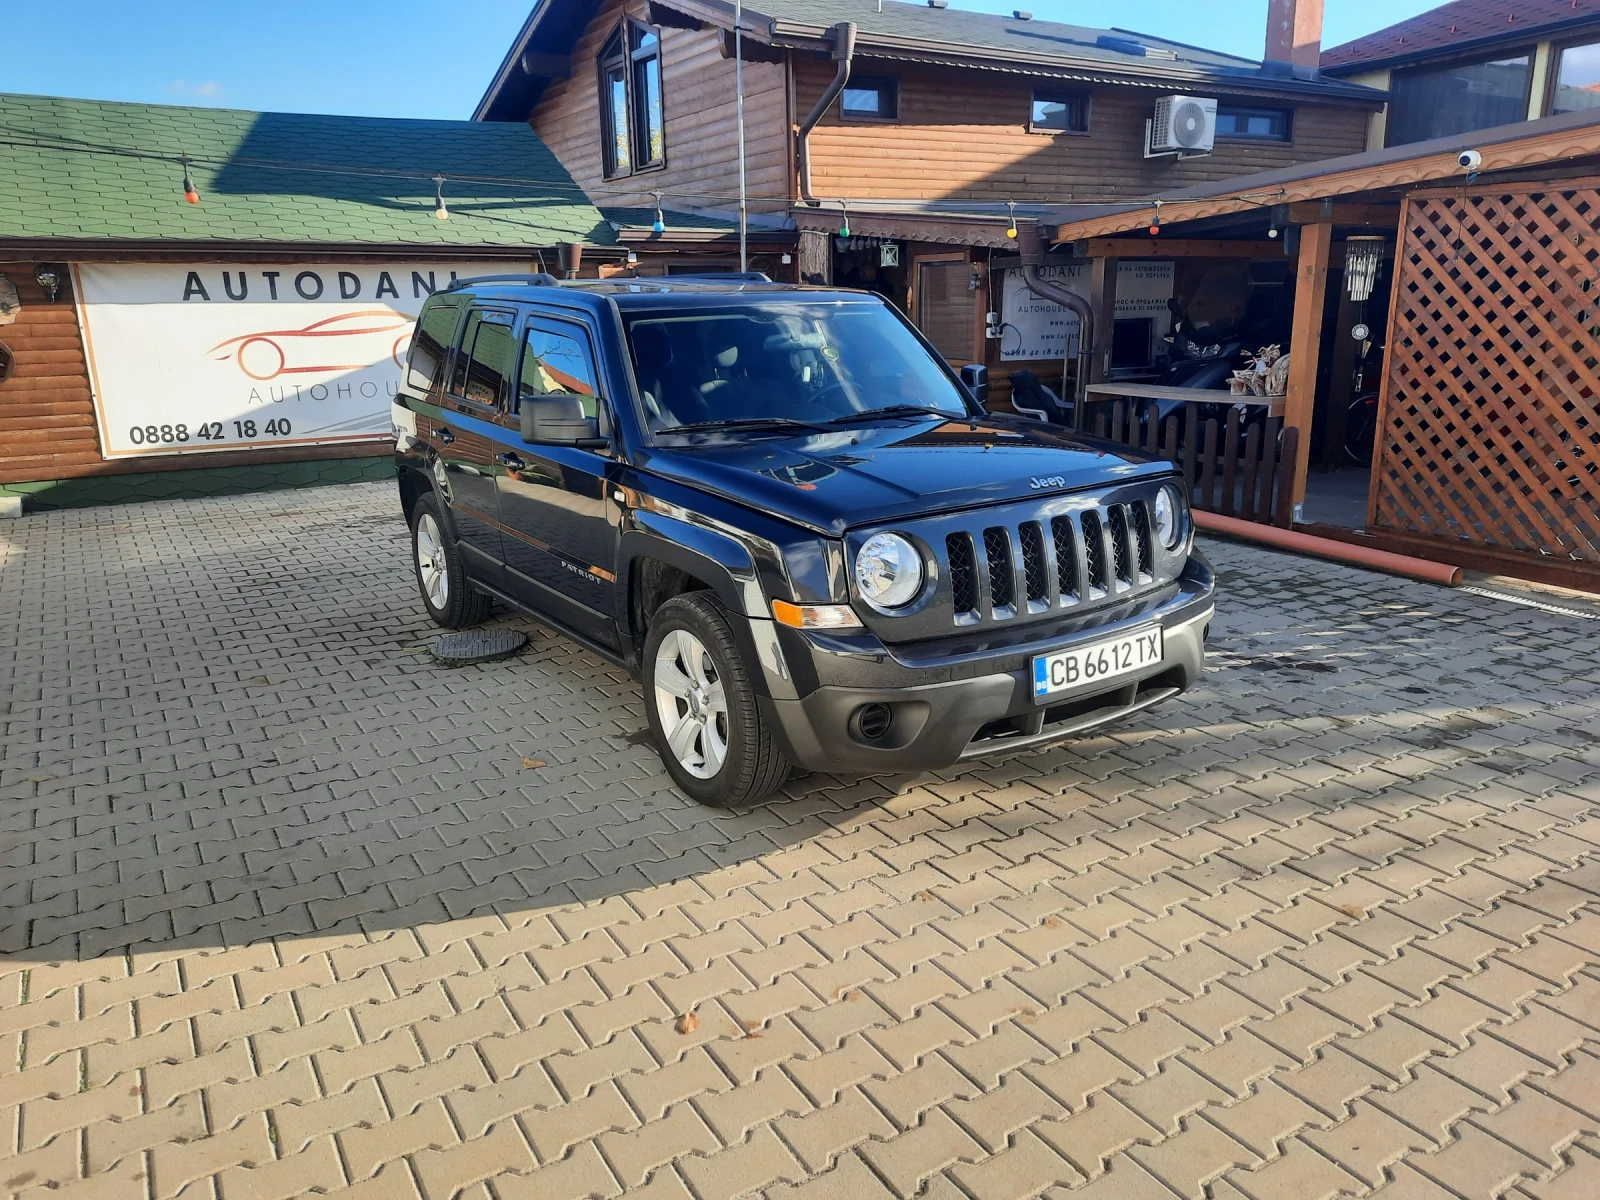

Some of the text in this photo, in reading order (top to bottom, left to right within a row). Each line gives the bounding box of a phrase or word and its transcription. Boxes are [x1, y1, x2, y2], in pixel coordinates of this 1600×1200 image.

[1009, 266, 1081, 278] AUODANI
[1018, 305, 1067, 313] AUTOHOUSE
[248, 380, 399, 404] AUTOHOU
[130, 417, 292, 444] 0888 42 18 40
[1029, 475, 1066, 491] Jeep
[561, 560, 602, 585] PATRIOT
[1050, 632, 1158, 687] CB 6612 TX
[1036, 681, 1047, 692] BG
